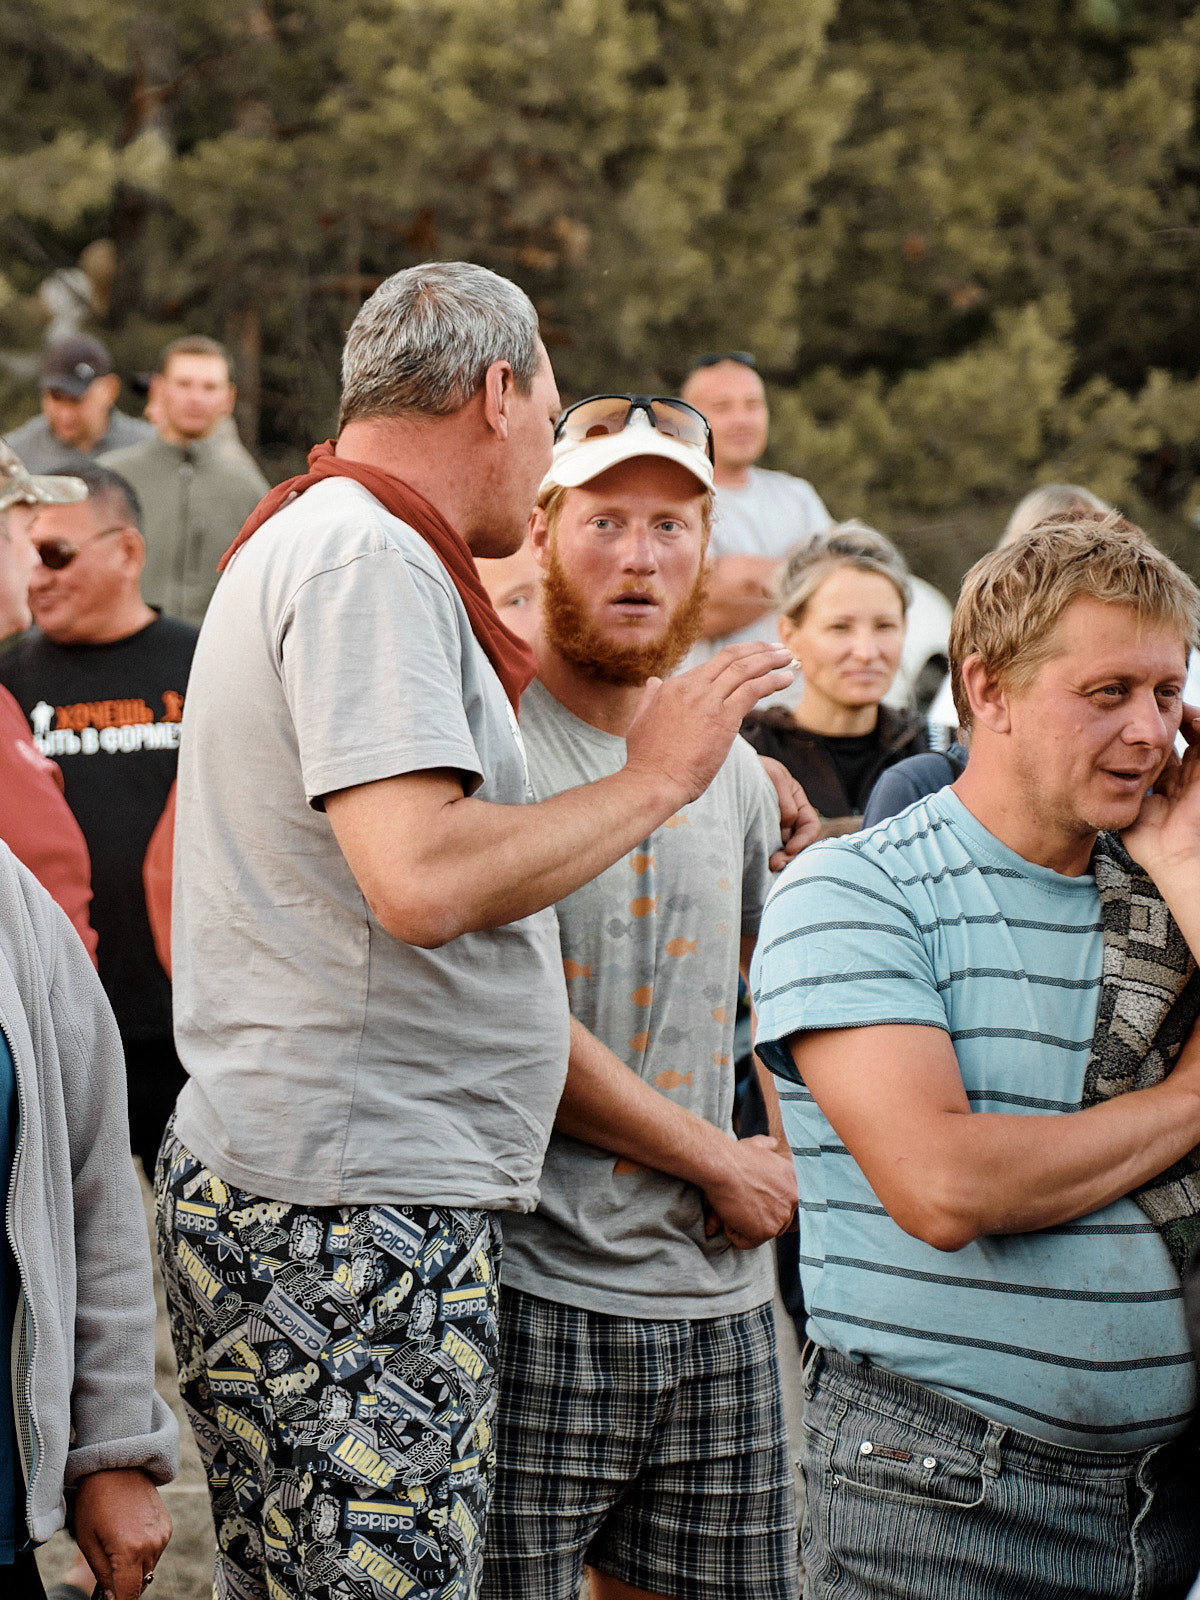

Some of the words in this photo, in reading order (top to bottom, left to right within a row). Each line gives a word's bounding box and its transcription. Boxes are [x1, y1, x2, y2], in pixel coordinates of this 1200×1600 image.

[442, 1298, 488, 1318] adidas
[333, 1434, 397, 1488] ADIDAS
[347, 1512, 414, 1531] adidas
[348, 1540, 417, 1600] ADIDAS
